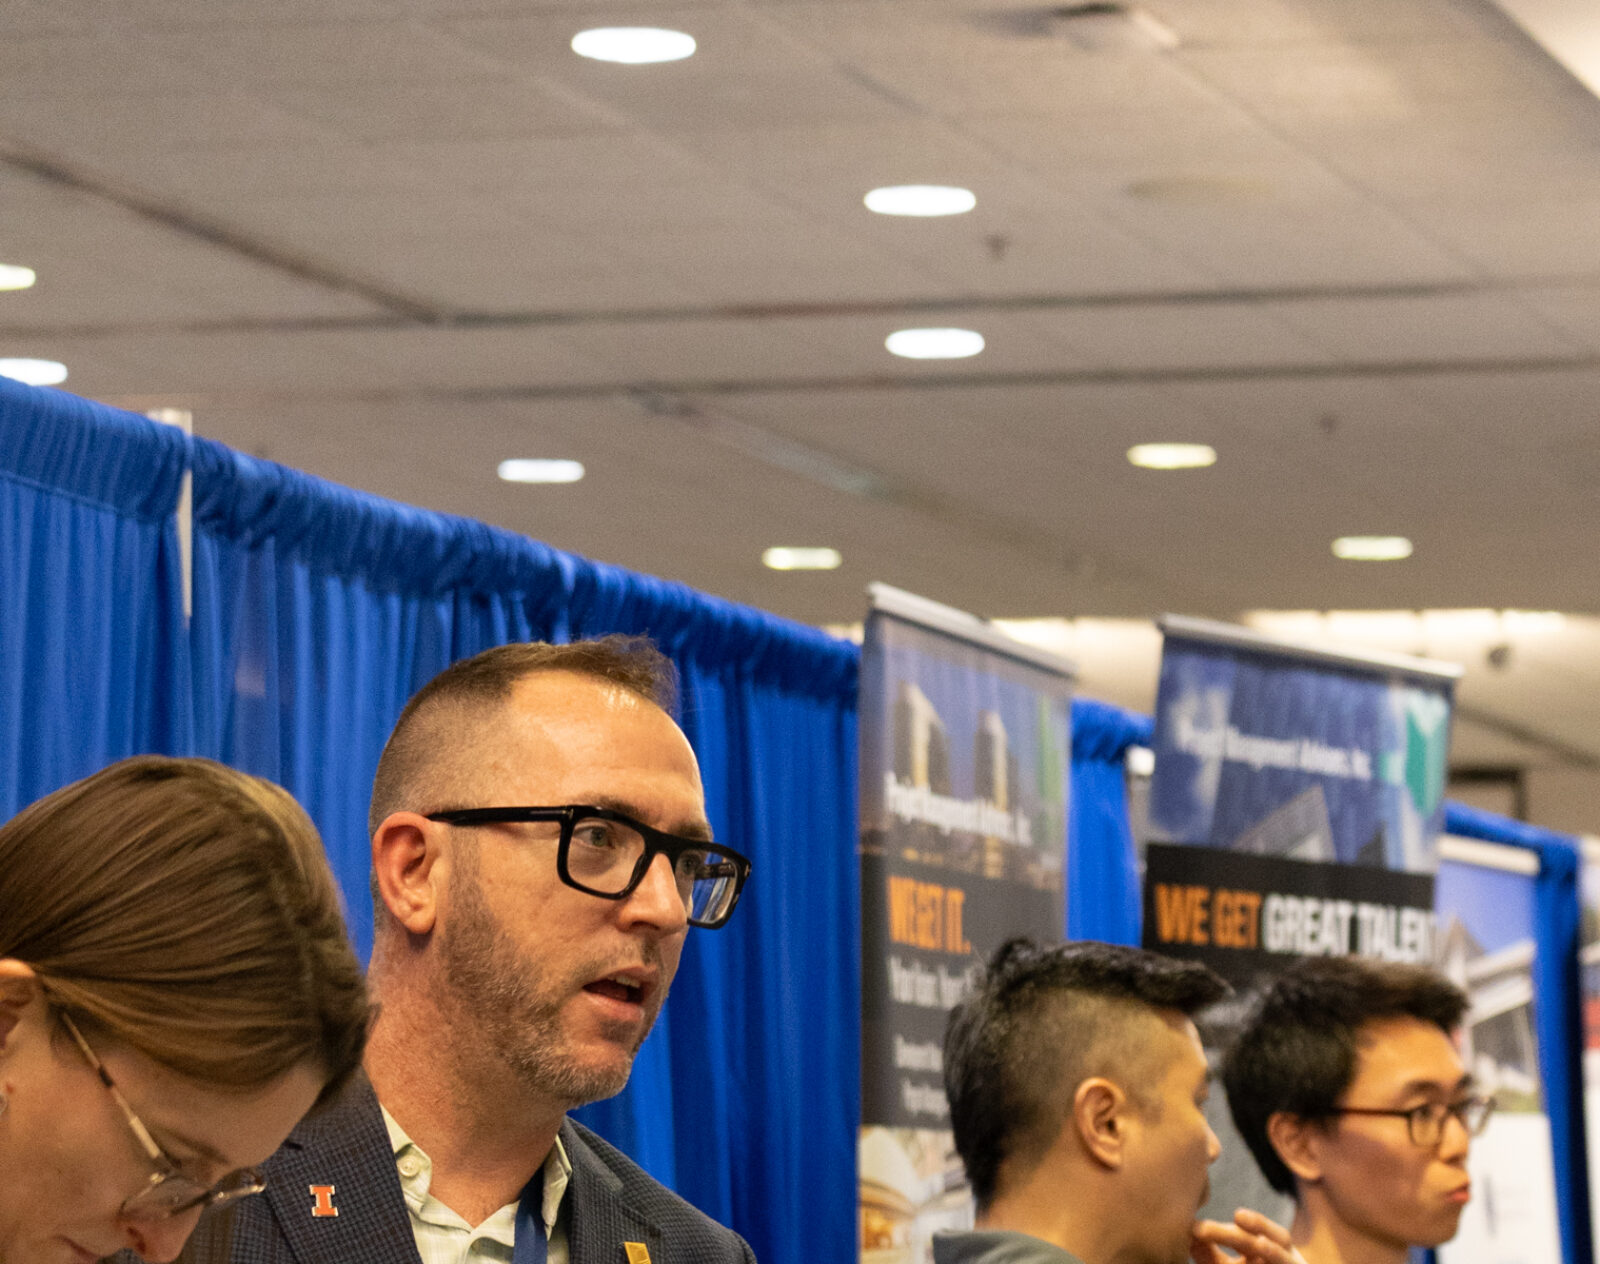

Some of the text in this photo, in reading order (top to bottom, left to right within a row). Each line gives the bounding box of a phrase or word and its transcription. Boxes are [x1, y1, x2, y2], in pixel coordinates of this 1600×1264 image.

[1154, 883, 1438, 964] WE GET GREAT TALEN
